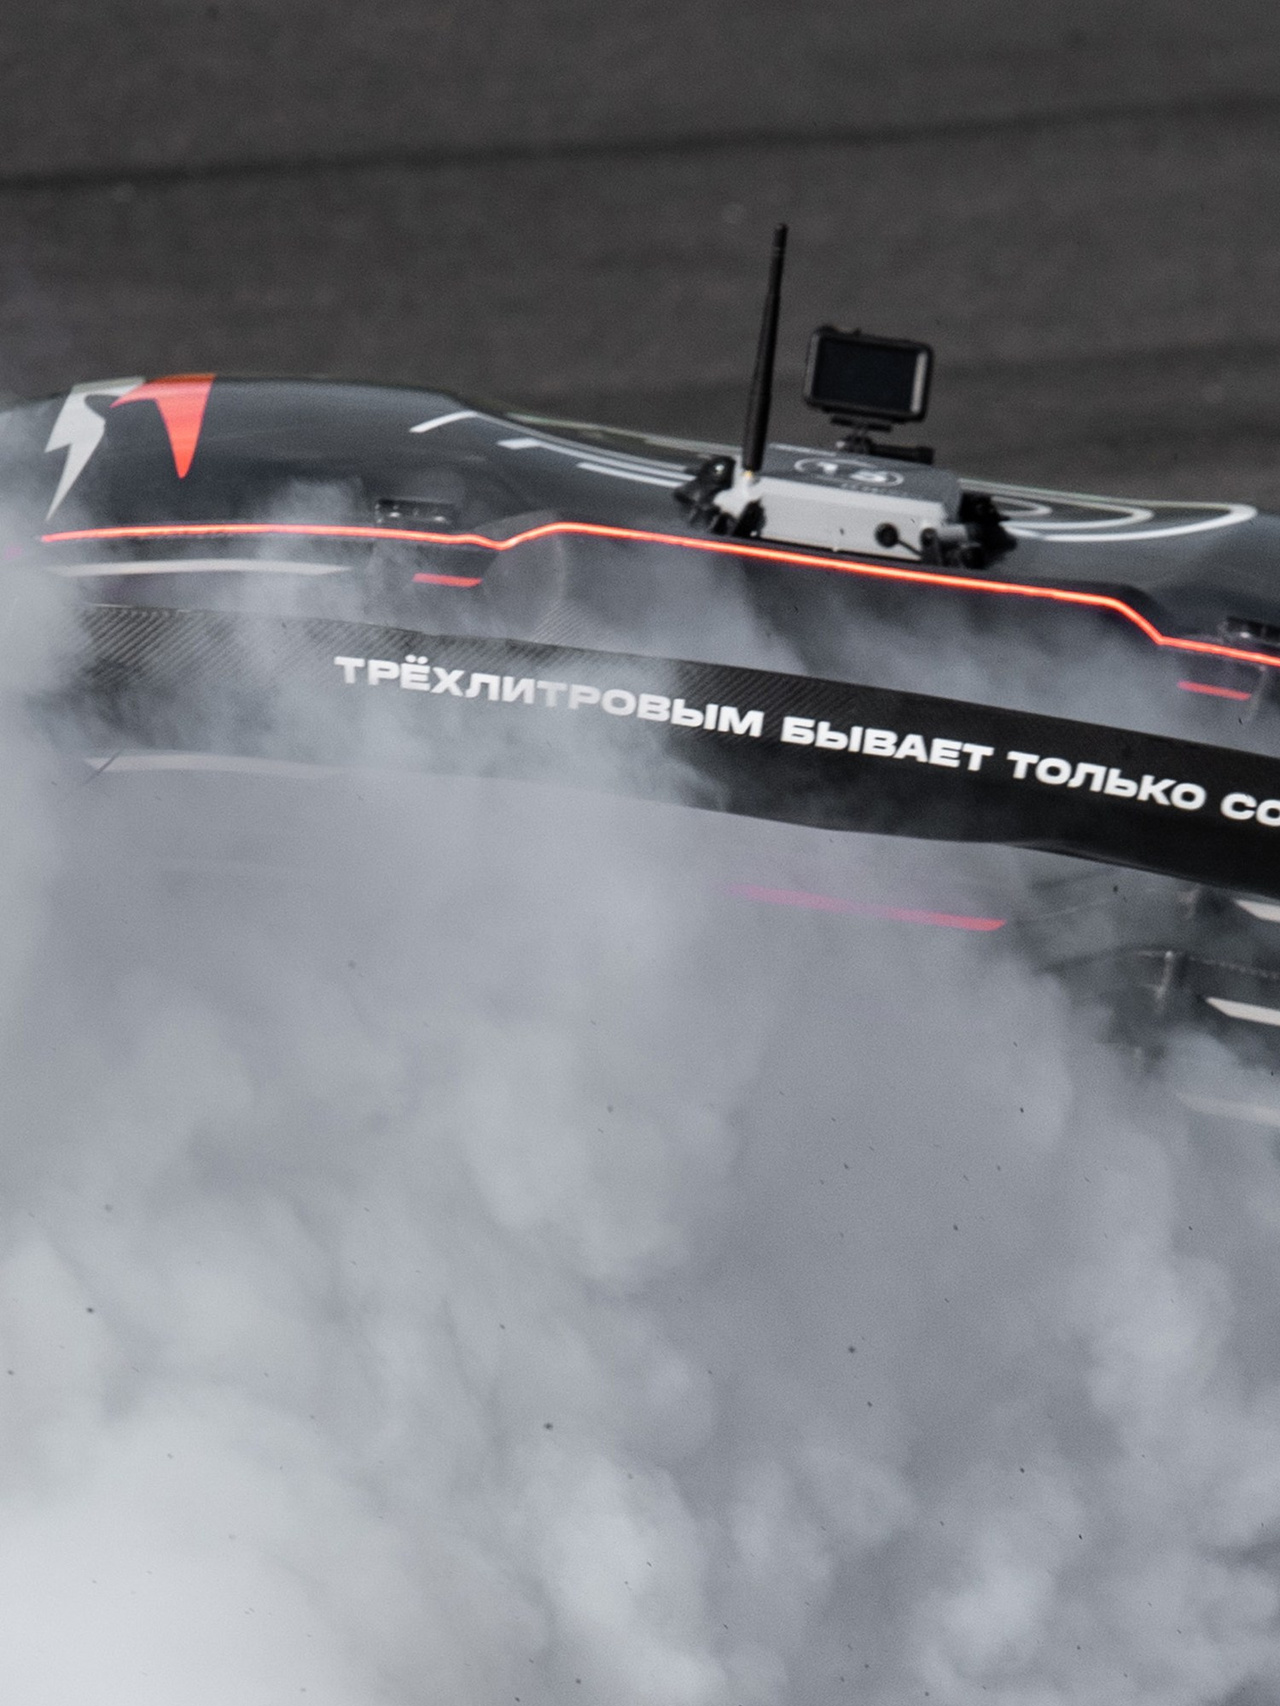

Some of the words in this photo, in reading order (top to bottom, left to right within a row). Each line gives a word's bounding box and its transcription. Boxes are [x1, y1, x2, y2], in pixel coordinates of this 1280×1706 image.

[334, 654, 764, 738] ТРЁХЛИТРОВЫМ
[780, 716, 993, 772] БЫВАЕТ
[1006, 750, 1207, 812] ТОЛЬКО
